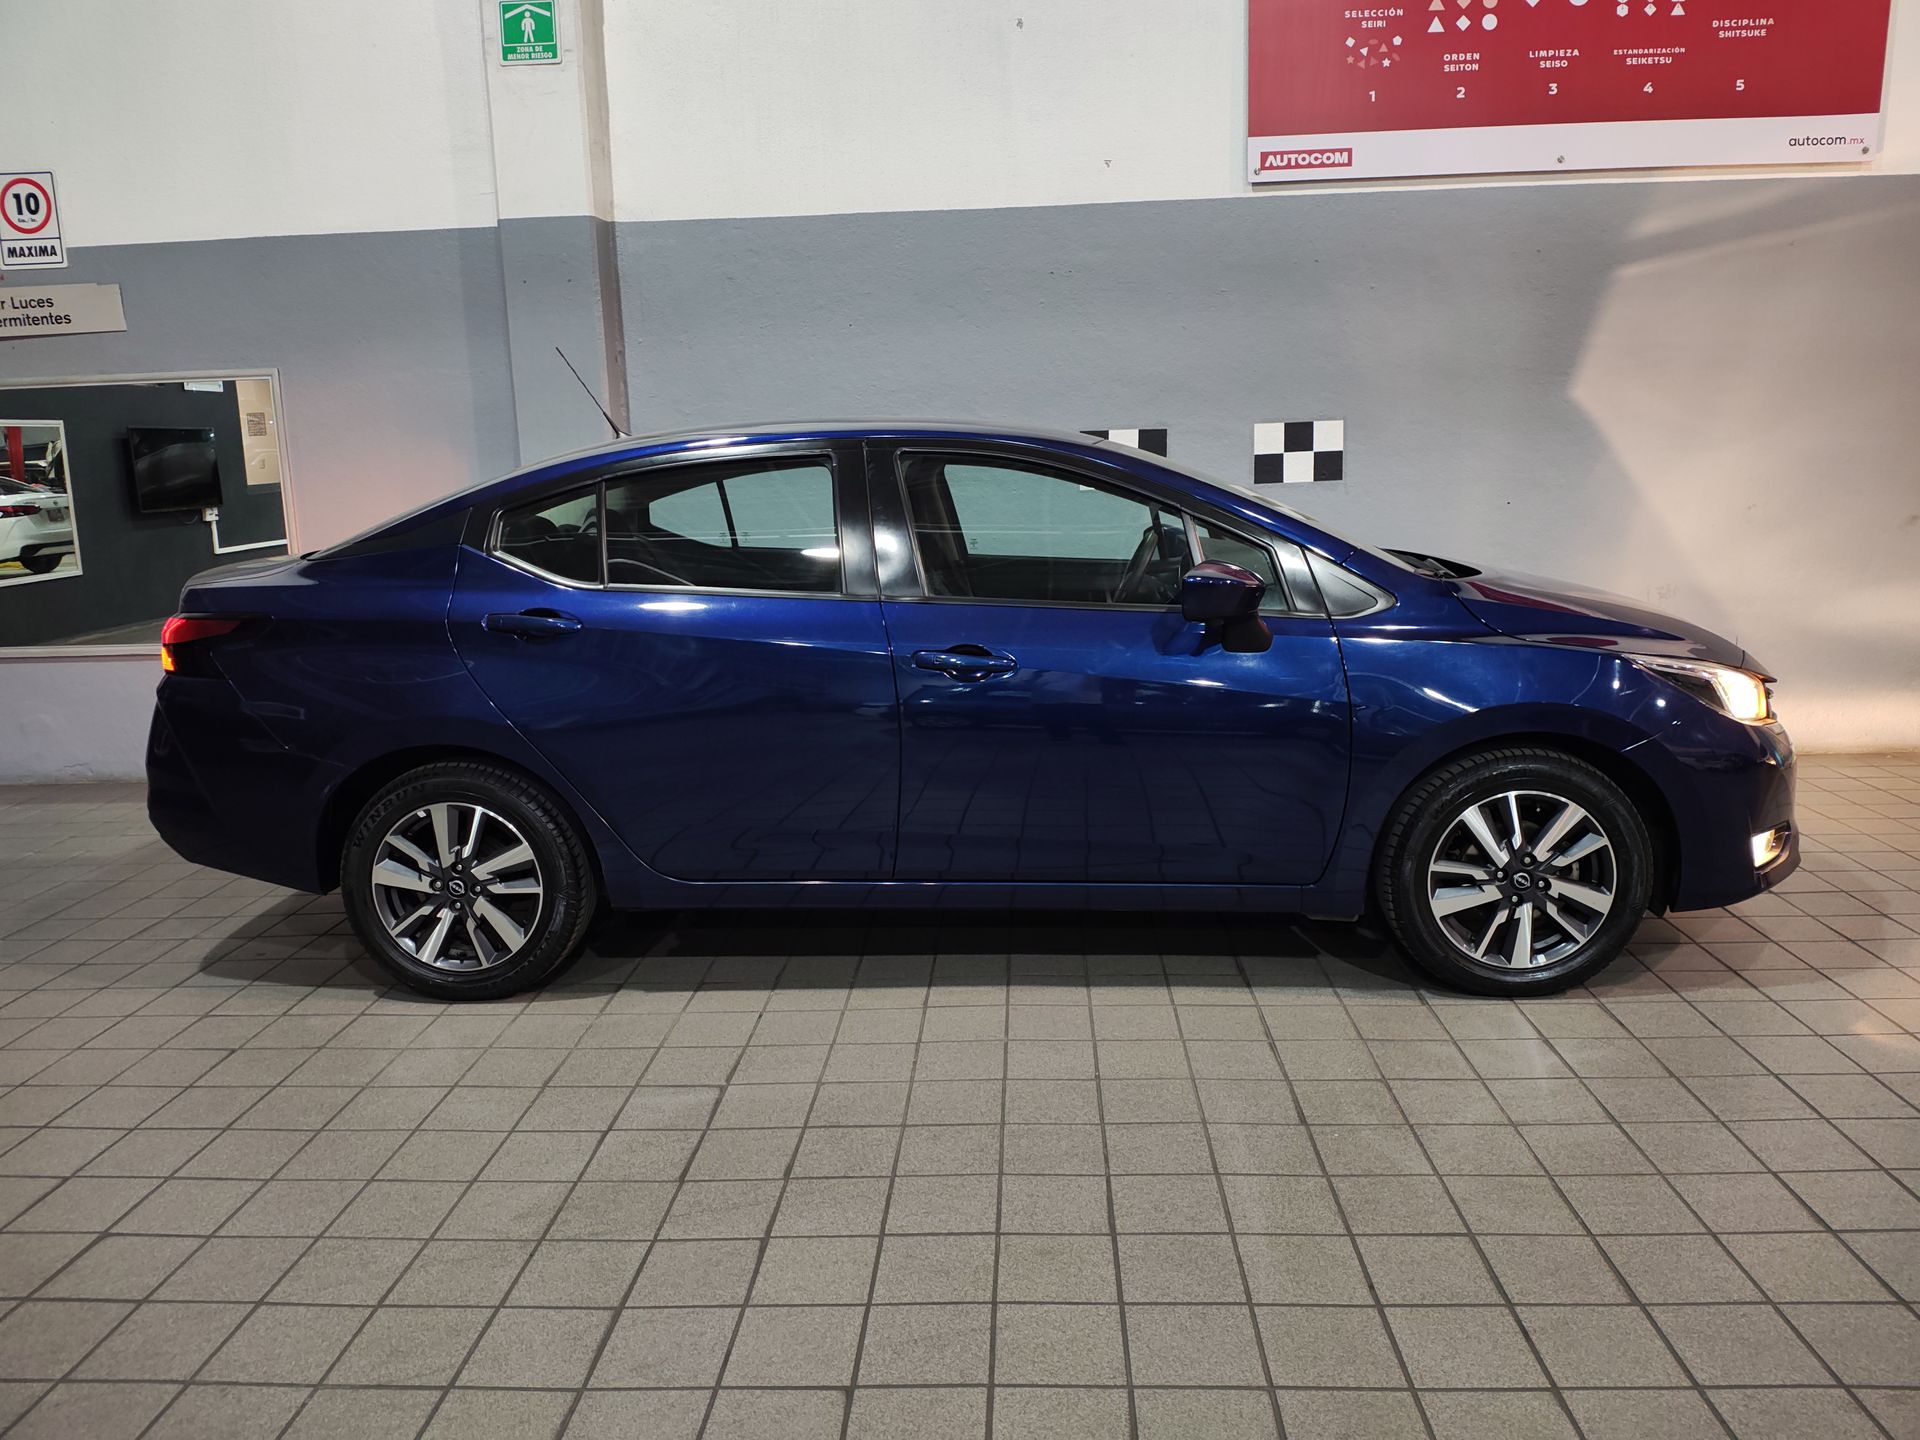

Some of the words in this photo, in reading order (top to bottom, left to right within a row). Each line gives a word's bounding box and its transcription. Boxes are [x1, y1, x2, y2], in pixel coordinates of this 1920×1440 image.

[1344, 8, 1404, 18] SELECCIÓN
[1361, 20, 1387, 28] SEIRI
[1712, 18, 1775, 28] DISCIPLINA
[1718, 29, 1767, 38] SHITSUKE
[1443, 52, 1480, 61] ORDEN
[1529, 49, 1580, 58] LIMPIEZA
[1613, 47, 1686, 56] ESTANDARIZACIÓN
[1539, 60, 1568, 68] SEISO
[1625, 56, 1673, 65] SEIKETSU
[1443, 63, 1479, 72] SEITON
[1548, 83, 1558, 95] 3
[1643, 81, 1654, 94] 4
[1735, 79, 1745, 91] 5
[1368, 90, 1377, 102] 1
[1456, 86, 1466, 99] 2
[1788, 135, 1865, 147] autocom.mx
[1264, 152, 1348, 167] AUTOCOM
[12, 192, 40, 216] 10
[7, 245, 58, 259] MAXIMA
[10, 296, 54, 310] Luces
